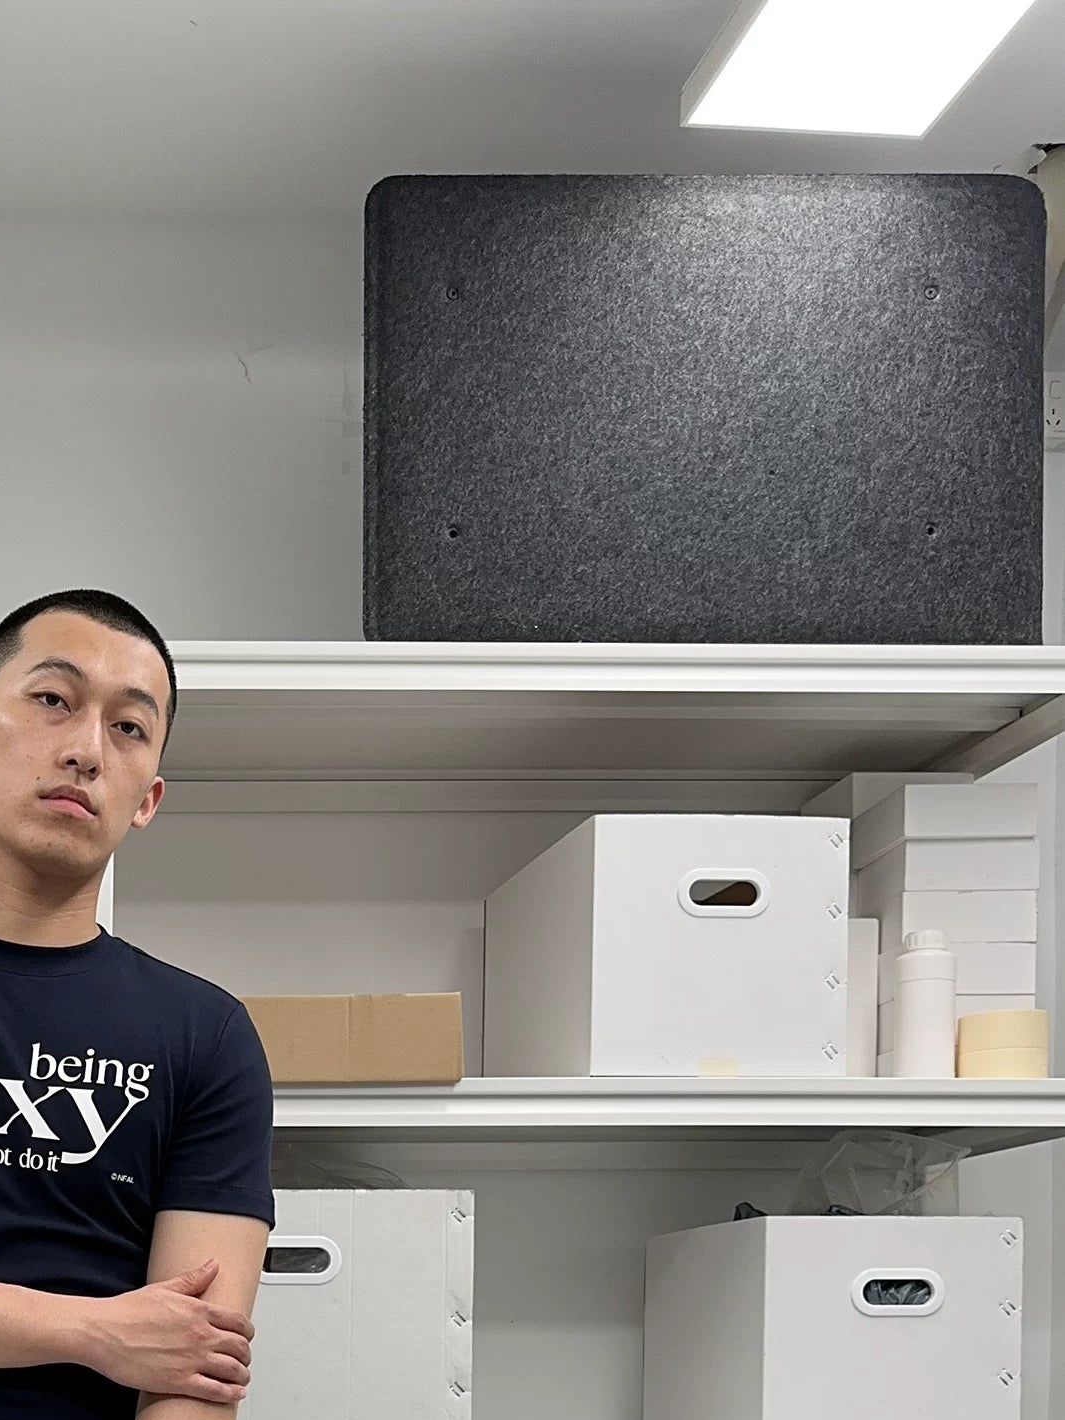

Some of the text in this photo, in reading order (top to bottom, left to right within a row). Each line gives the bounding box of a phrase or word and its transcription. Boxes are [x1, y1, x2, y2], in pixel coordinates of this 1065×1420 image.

[30, 1042, 155, 1101] being
[18, 1147, 44, 1171] do
[46, 1150, 62, 1173] it
